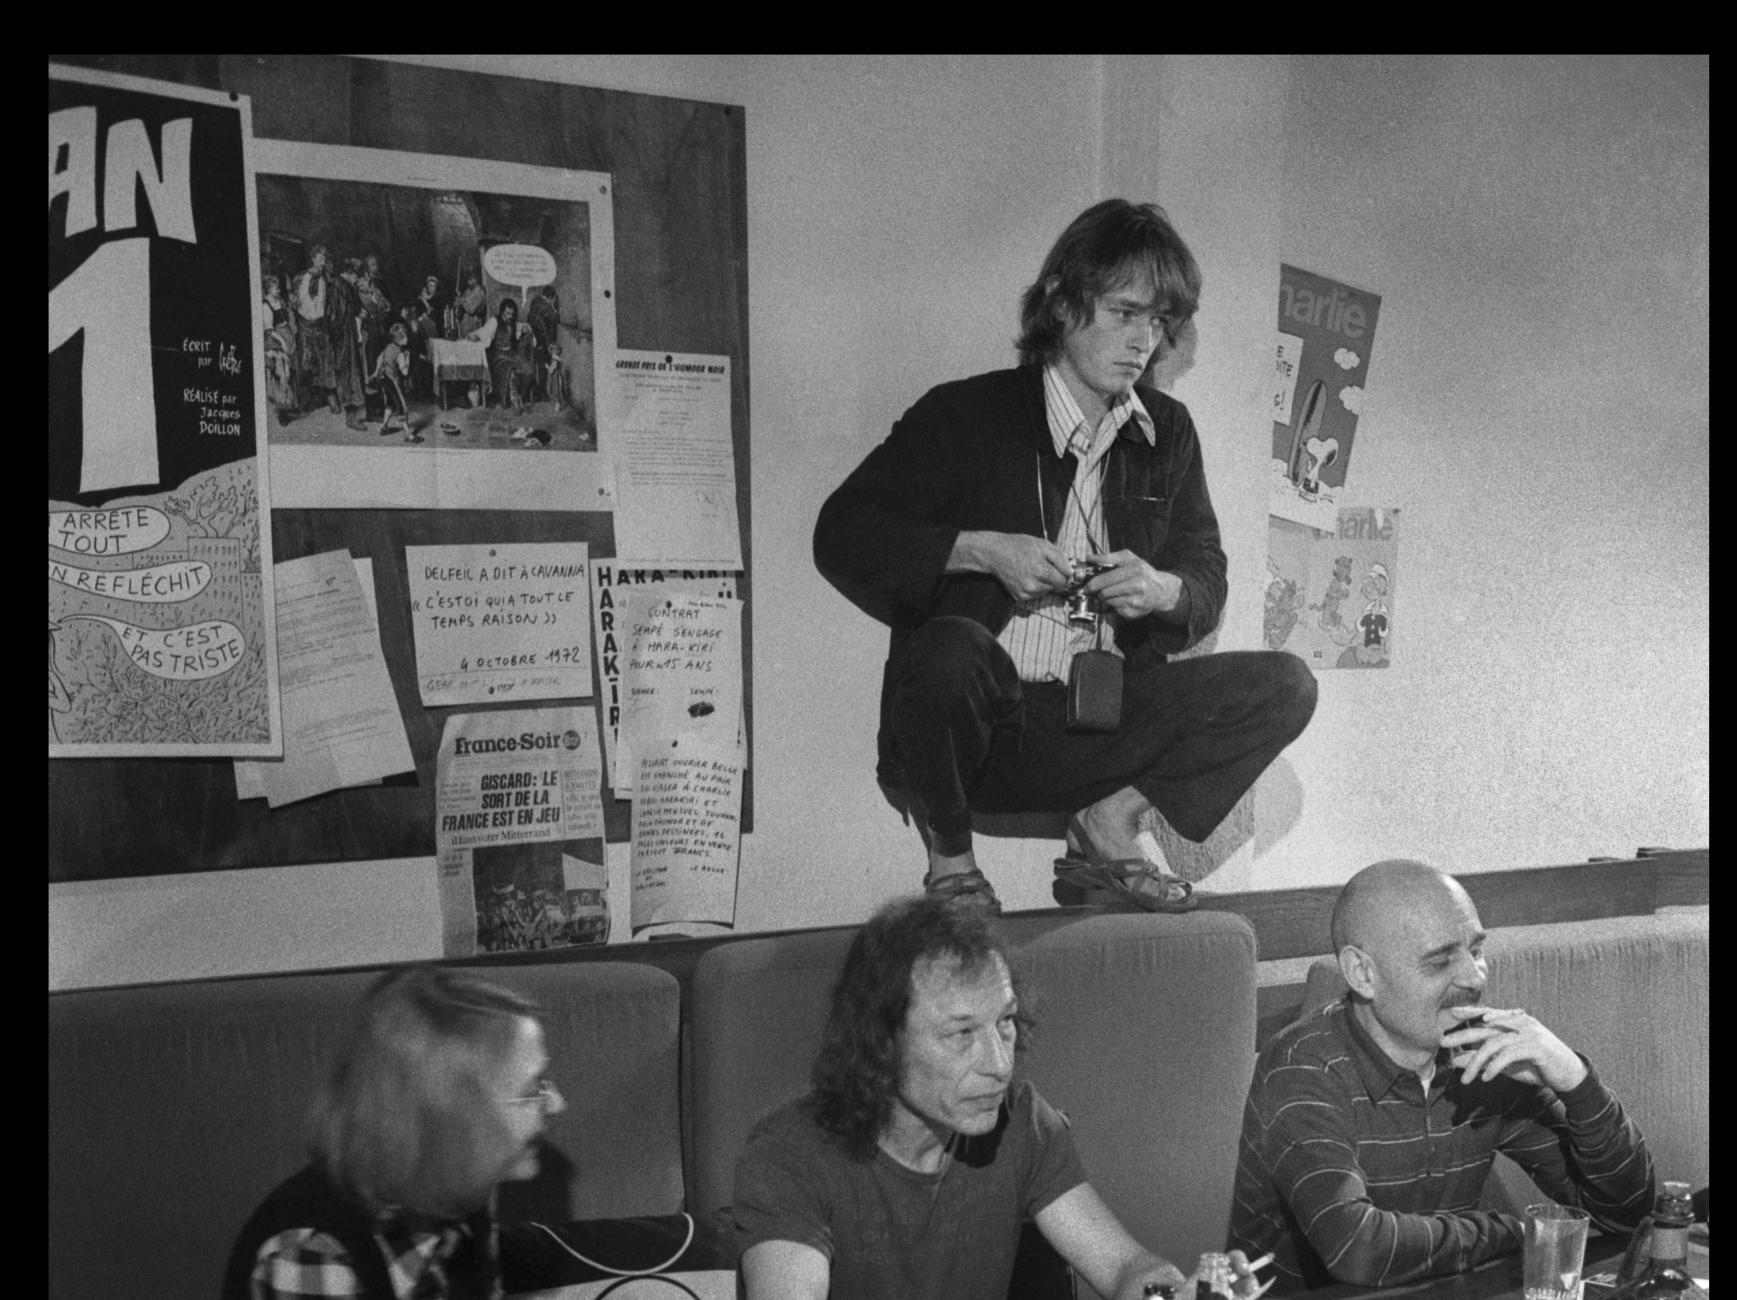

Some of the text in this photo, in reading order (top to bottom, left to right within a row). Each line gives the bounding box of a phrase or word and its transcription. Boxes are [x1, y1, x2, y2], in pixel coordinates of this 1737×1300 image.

[658, 362, 666, 371] DE
[669, 363, 705, 374] L'HUMOUR
[708, 366, 725, 374] NOIR
[200, 407, 240, 421] Jacques
[63, 509, 149, 530] ARRÊTE
[58, 530, 127, 554] TOUT
[425, 566, 473, 582] DELFEIL
[480, 568, 489, 582] A
[494, 566, 517, 580] DIT
[531, 564, 584, 579] CAVANNA
[520, 592, 554, 604] TOUT
[431, 615, 474, 629] TEMPS
[482, 609, 538, 626] RAISON
[648, 608, 700, 619] CONTRAT
[122, 625, 222, 648] ET C'EST
[673, 625, 722, 639] S'ENGAGE
[131, 639, 240, 674] PAS TRISTE
[477, 655, 536, 668] OCTOBRE
[545, 646, 580, 663] 1972
[685, 660, 712, 672] ANS
[454, 731, 561, 756] France-Soir
[480, 770, 558, 791] GISCARD: LE
[481, 791, 512, 809] SORT
[514, 790, 531, 807] DE
[533, 789, 550, 805] LA
[442, 807, 560, 831] FRANCE EST EN JEU
[476, 833, 499, 843] voter
[500, 828, 551, 842] Mitterrand
